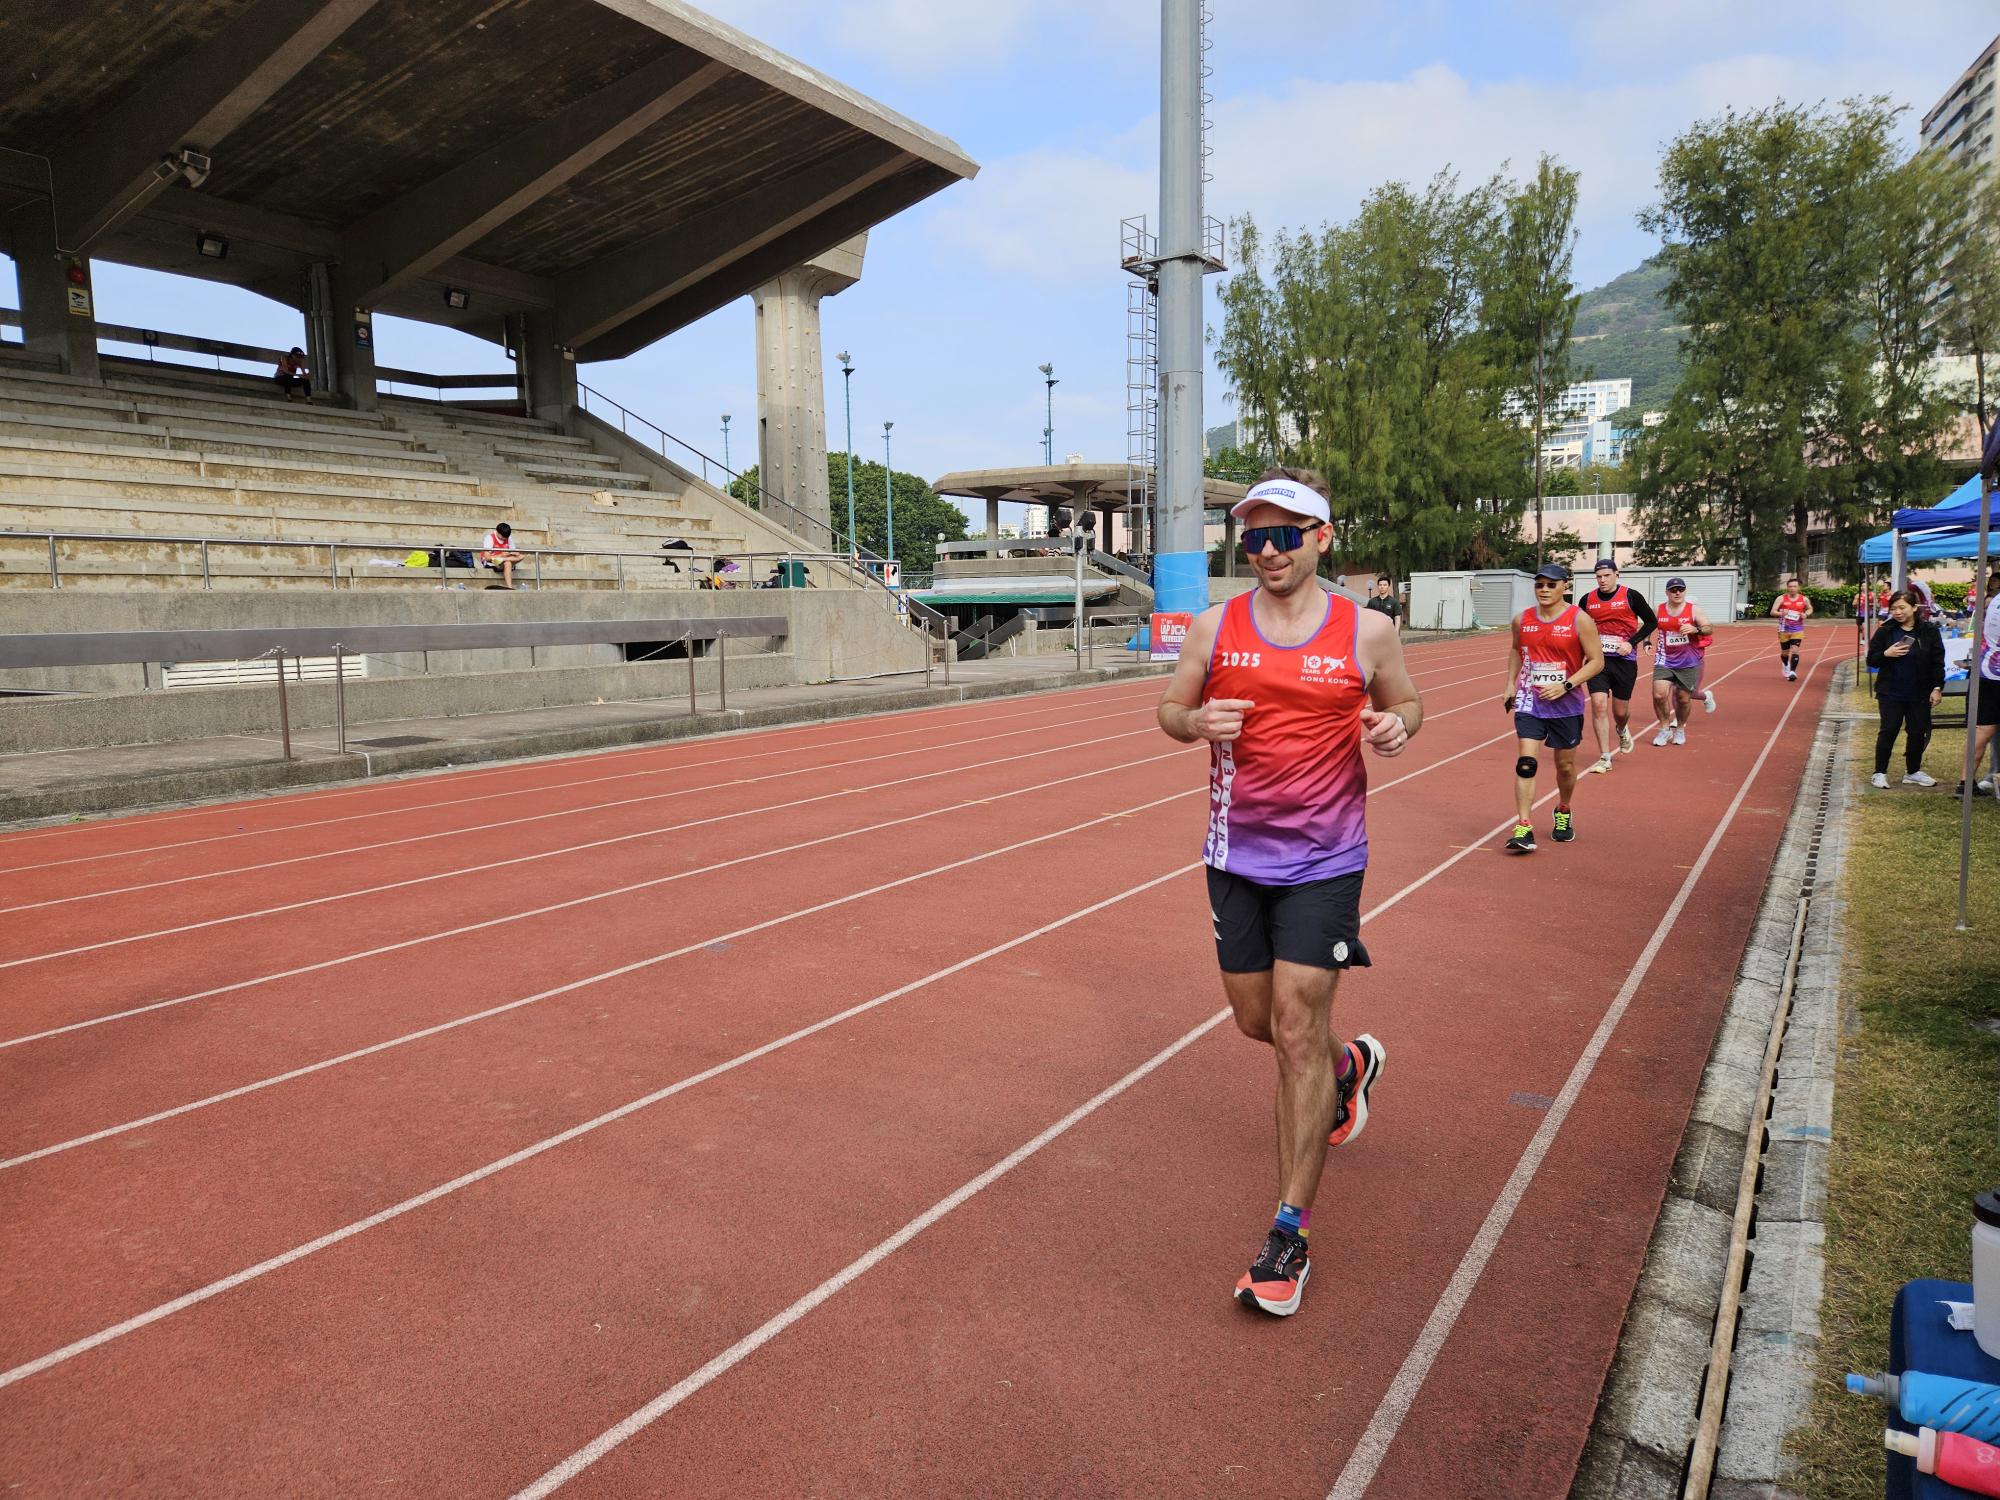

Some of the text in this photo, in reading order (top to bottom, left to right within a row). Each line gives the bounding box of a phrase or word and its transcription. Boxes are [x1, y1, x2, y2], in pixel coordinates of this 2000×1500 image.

[1522, 625, 1539, 633] 2025
[1222, 652, 1261, 667] 2025
[1302, 655, 1322, 669] 10
[1300, 675, 1350, 685] HONG KONG
[1533, 673, 1564, 682] WT03
